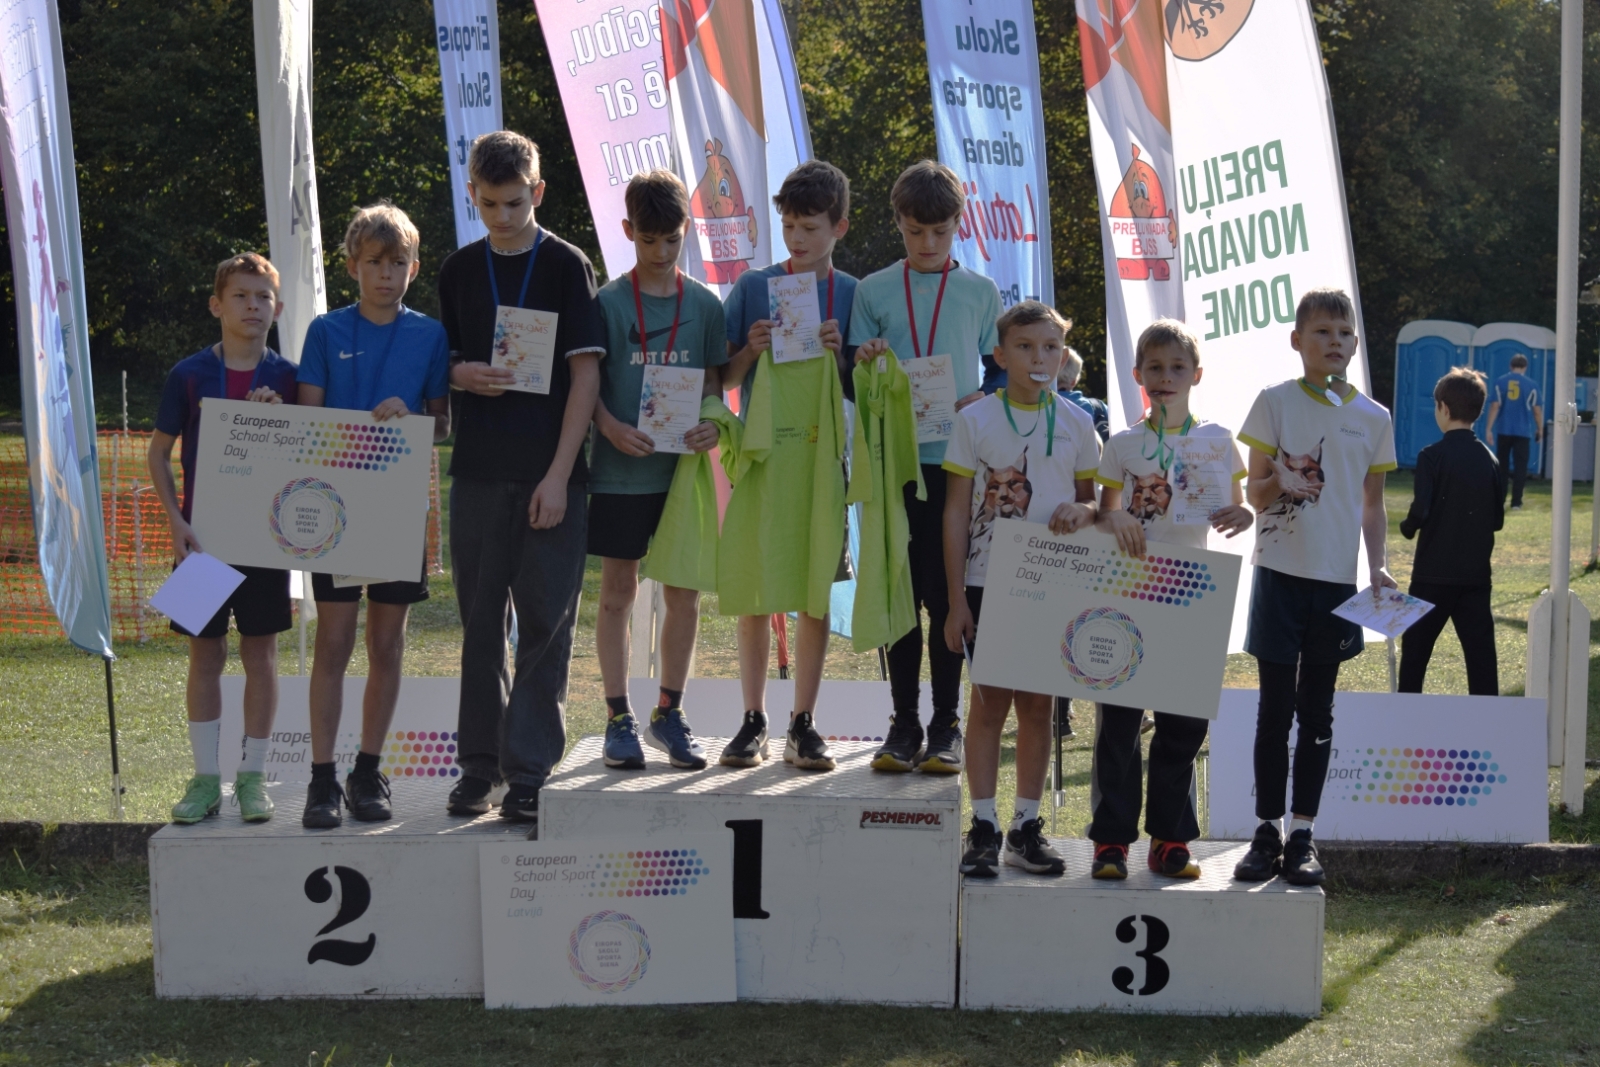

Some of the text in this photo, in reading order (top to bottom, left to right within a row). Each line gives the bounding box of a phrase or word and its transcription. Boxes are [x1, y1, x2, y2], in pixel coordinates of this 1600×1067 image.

[504, 320, 549, 334] DIPLOMS
[908, 367, 946, 380] IPLOMS
[651, 379, 695, 392] DIPLOMS
[1507, 380, 1520, 400] 5
[232, 413, 290, 430] European
[229, 430, 305, 446] School Sport
[223, 444, 248, 460] Day
[1027, 536, 1090, 556] European
[1022, 552, 1105, 575] School Sport
[1015, 567, 1042, 584] Day
[1090, 636, 1117, 645] EIROPAS
[1091, 643, 1113, 651] SKOLU
[1088, 650, 1114, 658] SPORTA
[1090, 657, 1110, 665] DIENA
[266, 749, 305, 763] chool
[1327, 767, 1363, 782] port
[861, 810, 942, 825] PESMENPOL
[515, 854, 577, 867] European
[513, 869, 596, 884] School Sport
[725, 819, 770, 919] 1
[510, 887, 536, 901] Day
[304, 865, 376, 967] 2
[1112, 914, 1170, 996] 3
